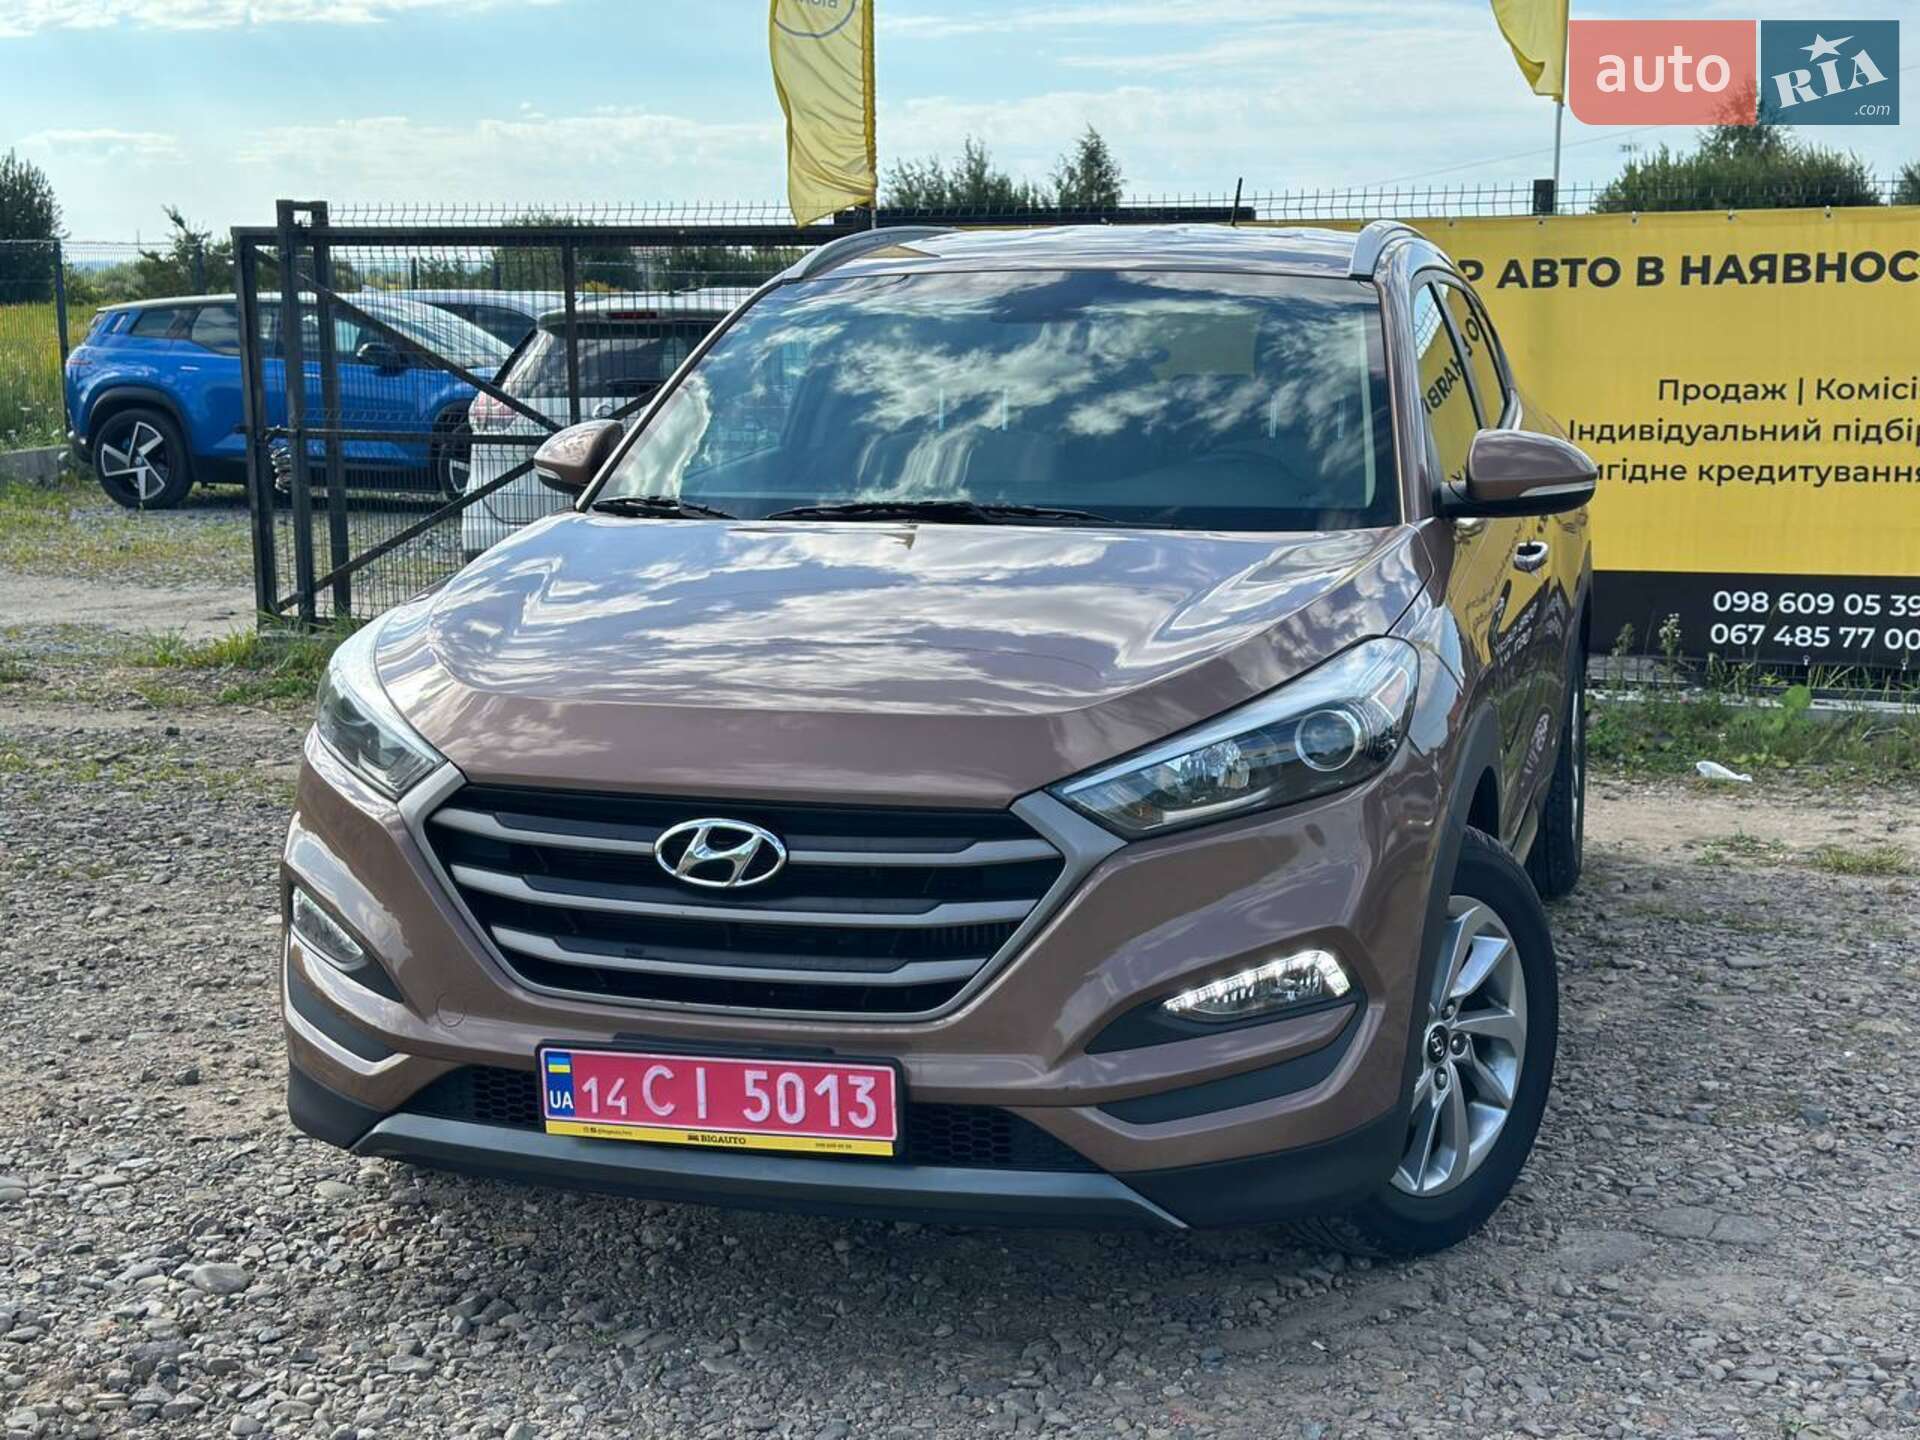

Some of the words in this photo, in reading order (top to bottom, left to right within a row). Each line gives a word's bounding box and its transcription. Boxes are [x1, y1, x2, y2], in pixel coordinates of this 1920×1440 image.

[1496, 256, 1621, 288] АВТО
[1636, 257, 1665, 286] В
[1658, 378, 1786, 403] Продаж
[1569, 418, 1821, 447] Індивідуальний
[1713, 591, 1769, 613] 098
[1779, 592, 1834, 614] 609
[1843, 593, 1881, 615] 05
[1710, 624, 1764, 646] 067
[1773, 625, 1830, 647] 485
[1839, 627, 1875, 648] 77
[1884, 628, 1920, 649] 00
[550, 1090, 574, 1109] UA
[581, 1076, 628, 1116] 14
[743, 1070, 877, 1128] 5013
